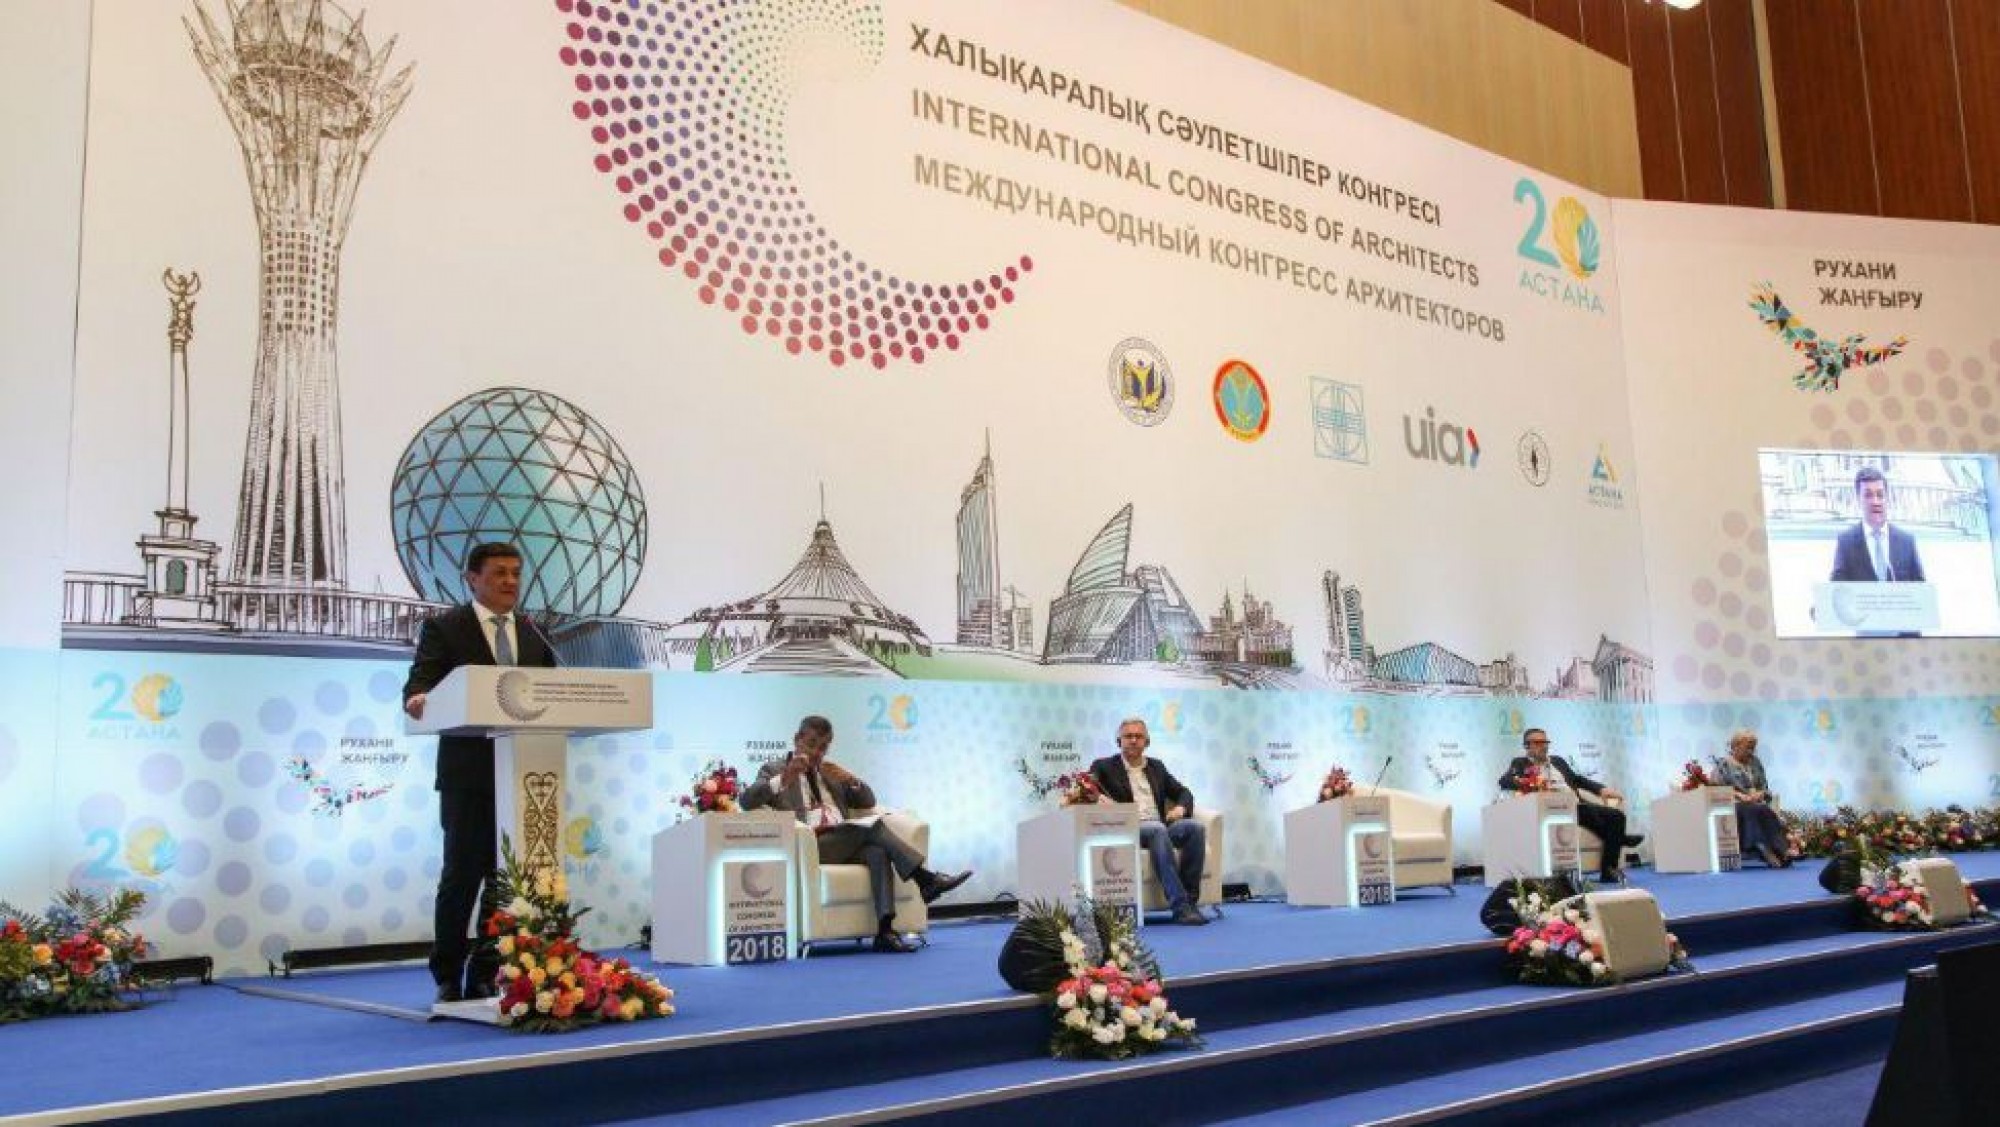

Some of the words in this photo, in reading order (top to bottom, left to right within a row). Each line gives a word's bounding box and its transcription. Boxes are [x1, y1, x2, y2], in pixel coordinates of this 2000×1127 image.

[911, 22, 1151, 134] ХАЛЫҚАРАЛЫҚ
[1157, 109, 1331, 188] СӘУЛЕТШІЛЕР
[1338, 170, 1441, 227] КОНГРЕСІ
[912, 88, 1160, 190] INTERNATIONAL
[1168, 169, 1308, 234] CONGRESS
[1316, 214, 1344, 244] OF
[1351, 227, 1479, 287] ARCHITECTS
[914, 154, 1200, 259] МЕЖДУНАРОДНЫЙ
[1209, 237, 1338, 295] КОНГРЕСС
[1347, 276, 1505, 342] АРХИТЕКТОРОВ
[1814, 260, 1896, 279] РУХАНИ
[1519, 270, 1604, 313] АСТАНА
[1819, 287, 1923, 310] ЖАҢҒЫРУ
[1403, 405, 1465, 466] uia
[340, 738, 393, 748] РУХАНИ
[730, 935, 785, 962] 2018
